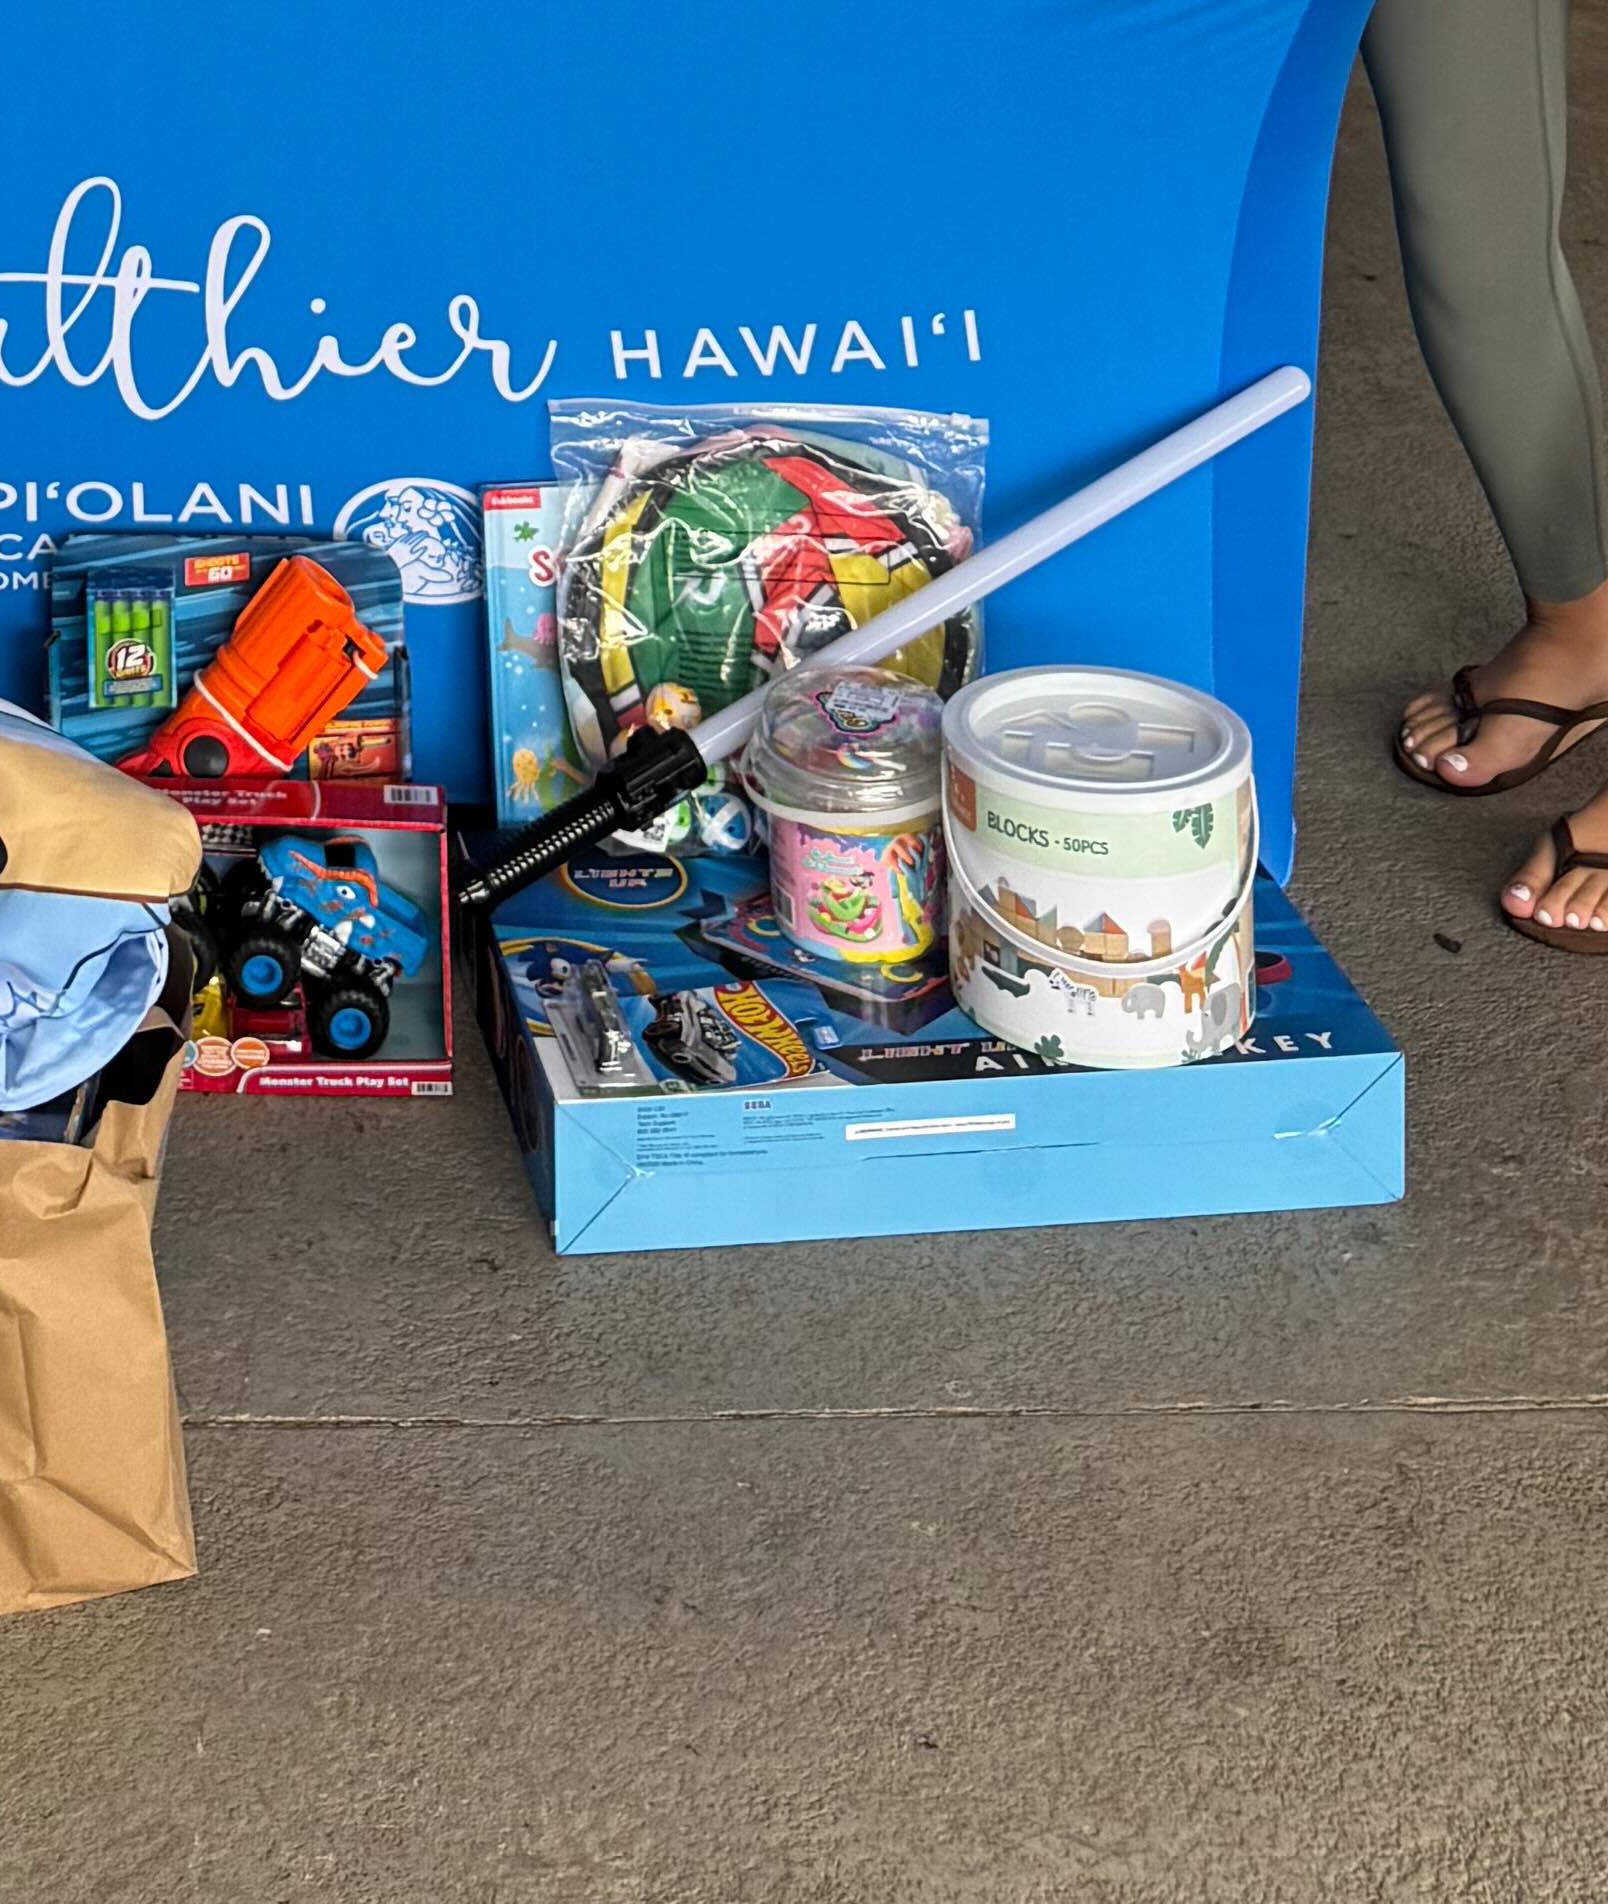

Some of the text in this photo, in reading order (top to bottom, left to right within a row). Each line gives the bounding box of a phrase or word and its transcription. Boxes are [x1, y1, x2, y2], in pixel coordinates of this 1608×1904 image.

[116, 643, 146, 671] 12
[987, 810, 1050, 848] BLOCKS
[1063, 837, 1110, 855] 50PCS
[1228, 1030, 1333, 1057] KEY
[258, 1076, 409, 1090] Monster Truck Play Set
